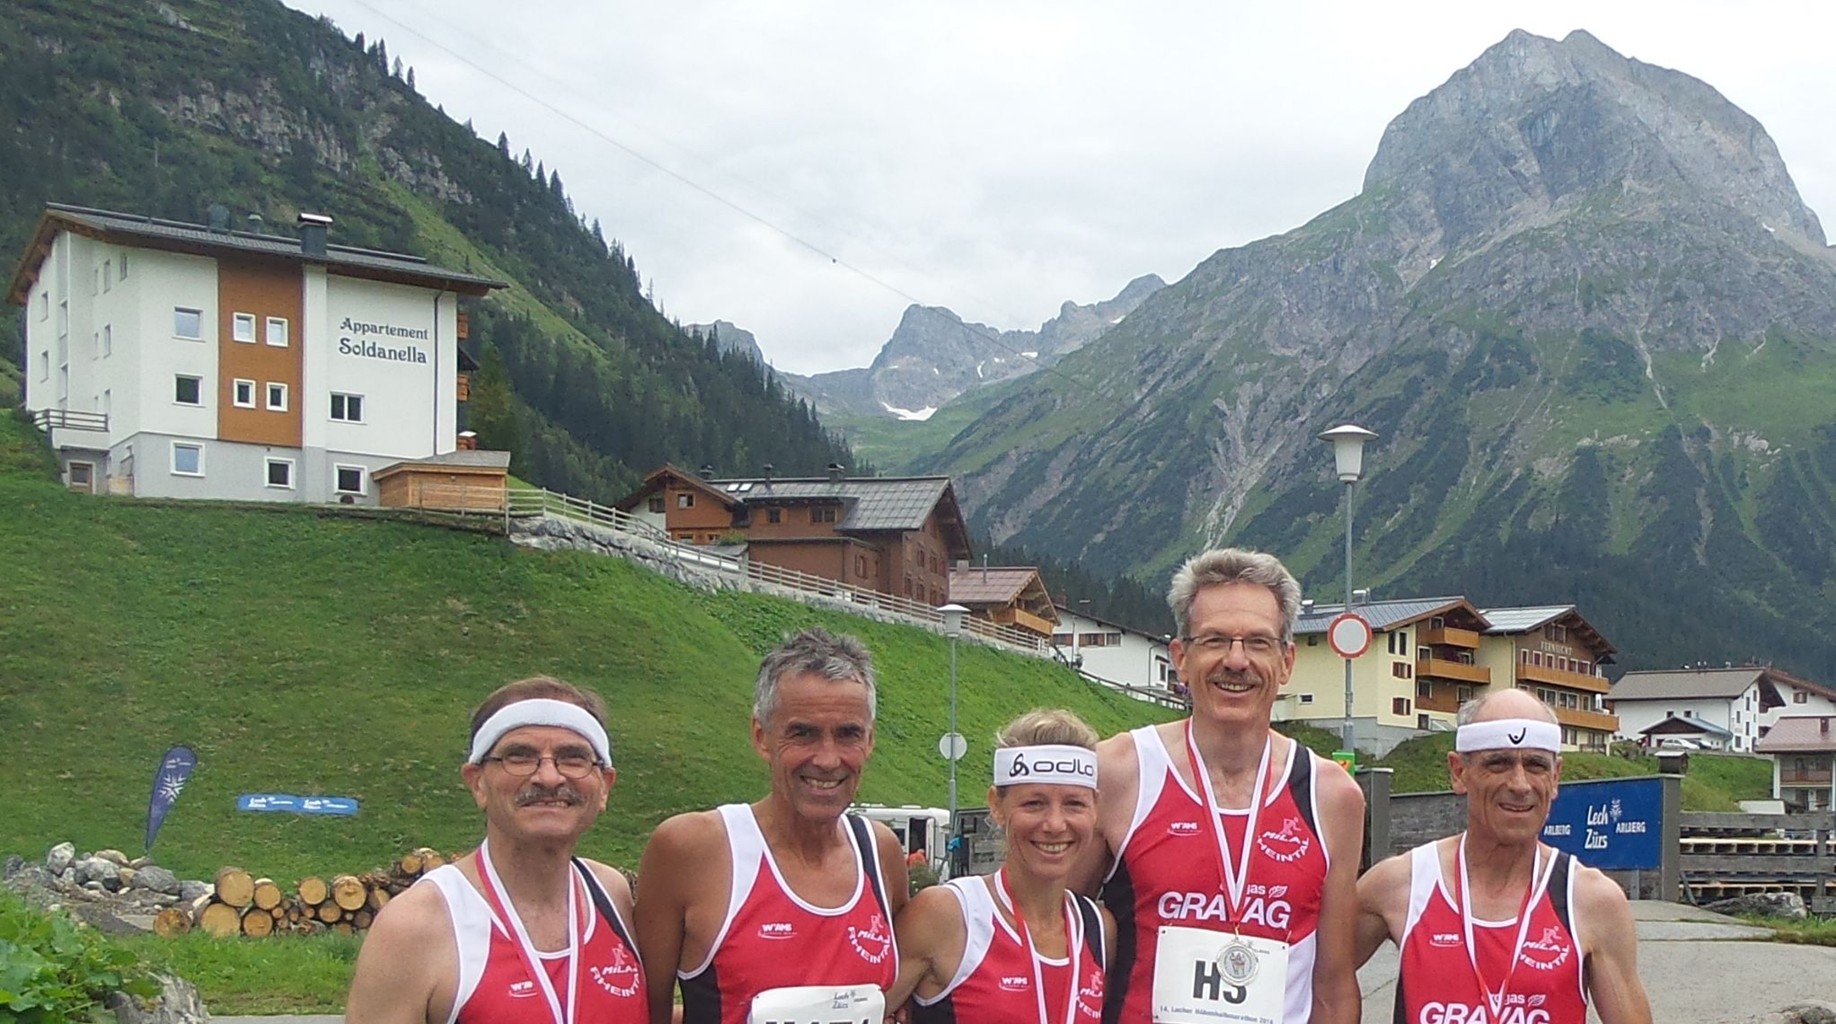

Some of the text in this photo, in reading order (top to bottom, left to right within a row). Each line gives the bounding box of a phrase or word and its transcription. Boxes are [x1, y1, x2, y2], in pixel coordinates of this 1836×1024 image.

[340, 317, 428, 340] Appartement
[339, 337, 427, 364] Soldanella
[1587, 804, 1609, 826] Lech
[1584, 828, 1608, 850] Zürs
